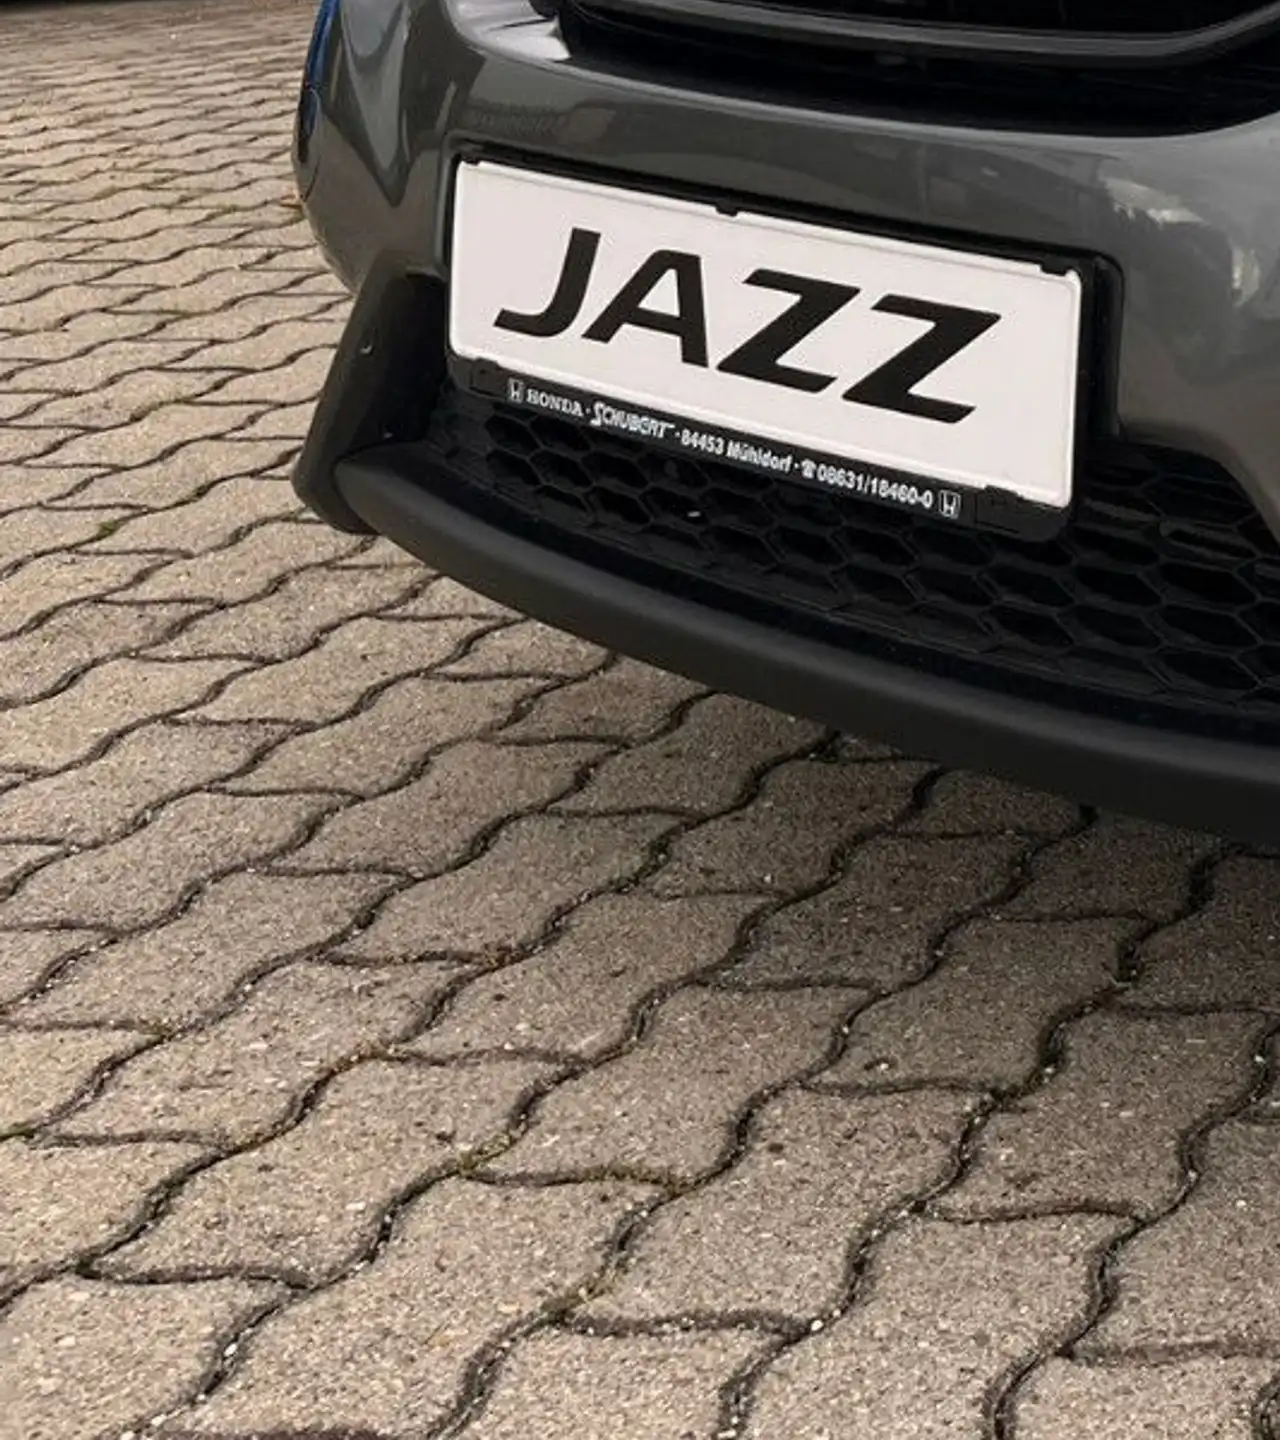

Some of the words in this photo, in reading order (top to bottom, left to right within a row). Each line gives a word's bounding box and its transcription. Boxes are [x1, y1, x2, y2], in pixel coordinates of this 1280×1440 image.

[493, 227, 1002, 424] JAZZ
[525, 388, 584, 416] HONDA
[680, 428, 724, 455] 84453
[726, 437, 793, 474] Mühldorf
